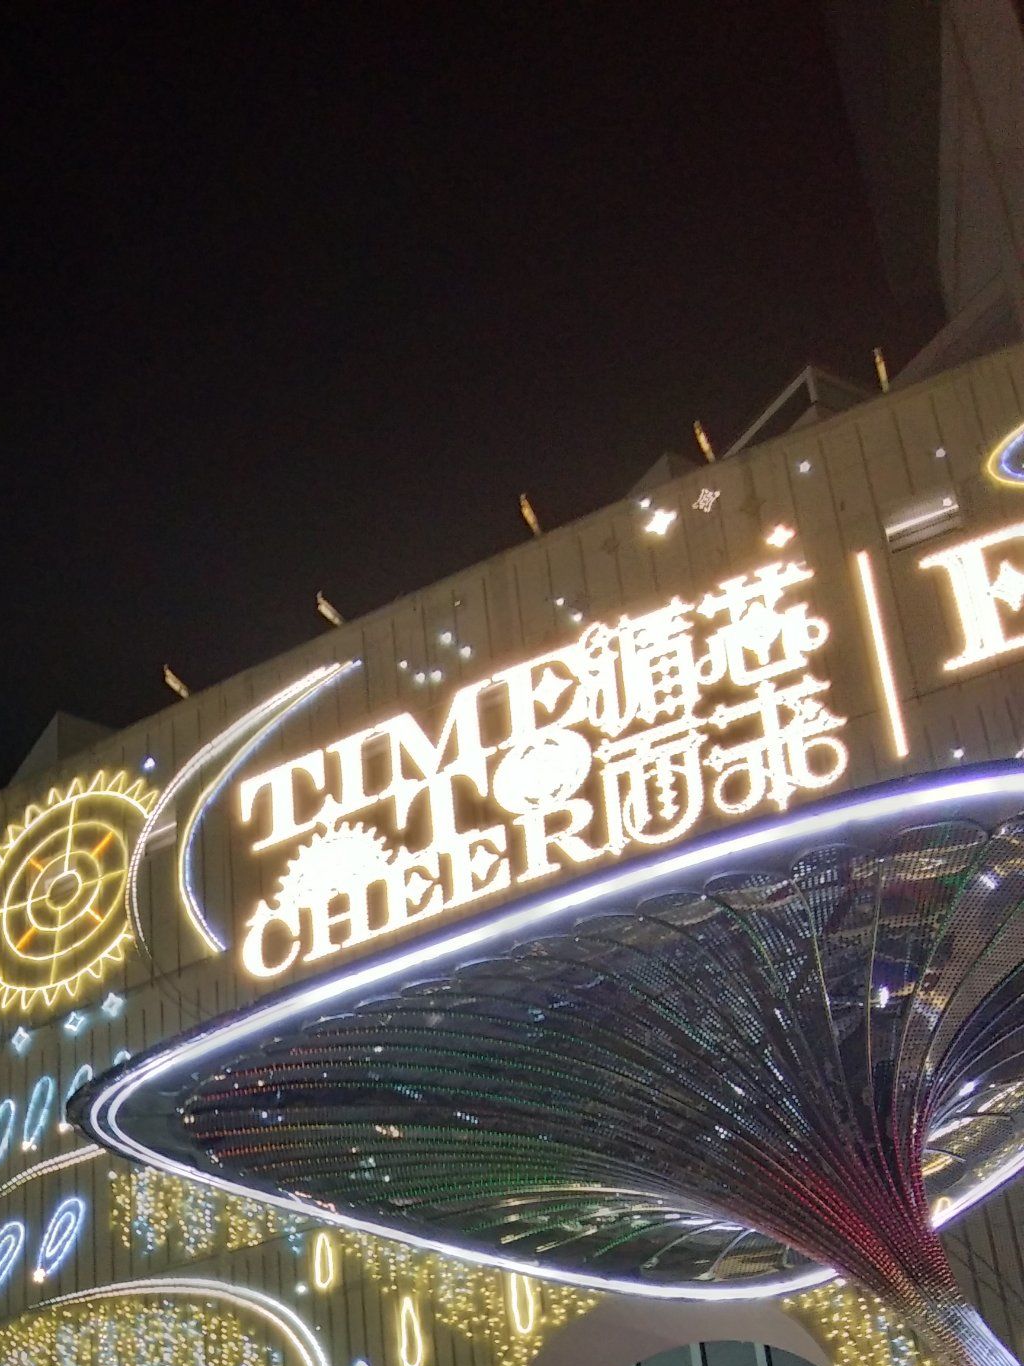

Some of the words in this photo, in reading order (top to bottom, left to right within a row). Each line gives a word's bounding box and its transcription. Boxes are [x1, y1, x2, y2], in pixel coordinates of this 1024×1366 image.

[240, 641, 590, 852] TIME
[391, 728, 592, 858] TO
[241, 798, 611, 977] CHEER
